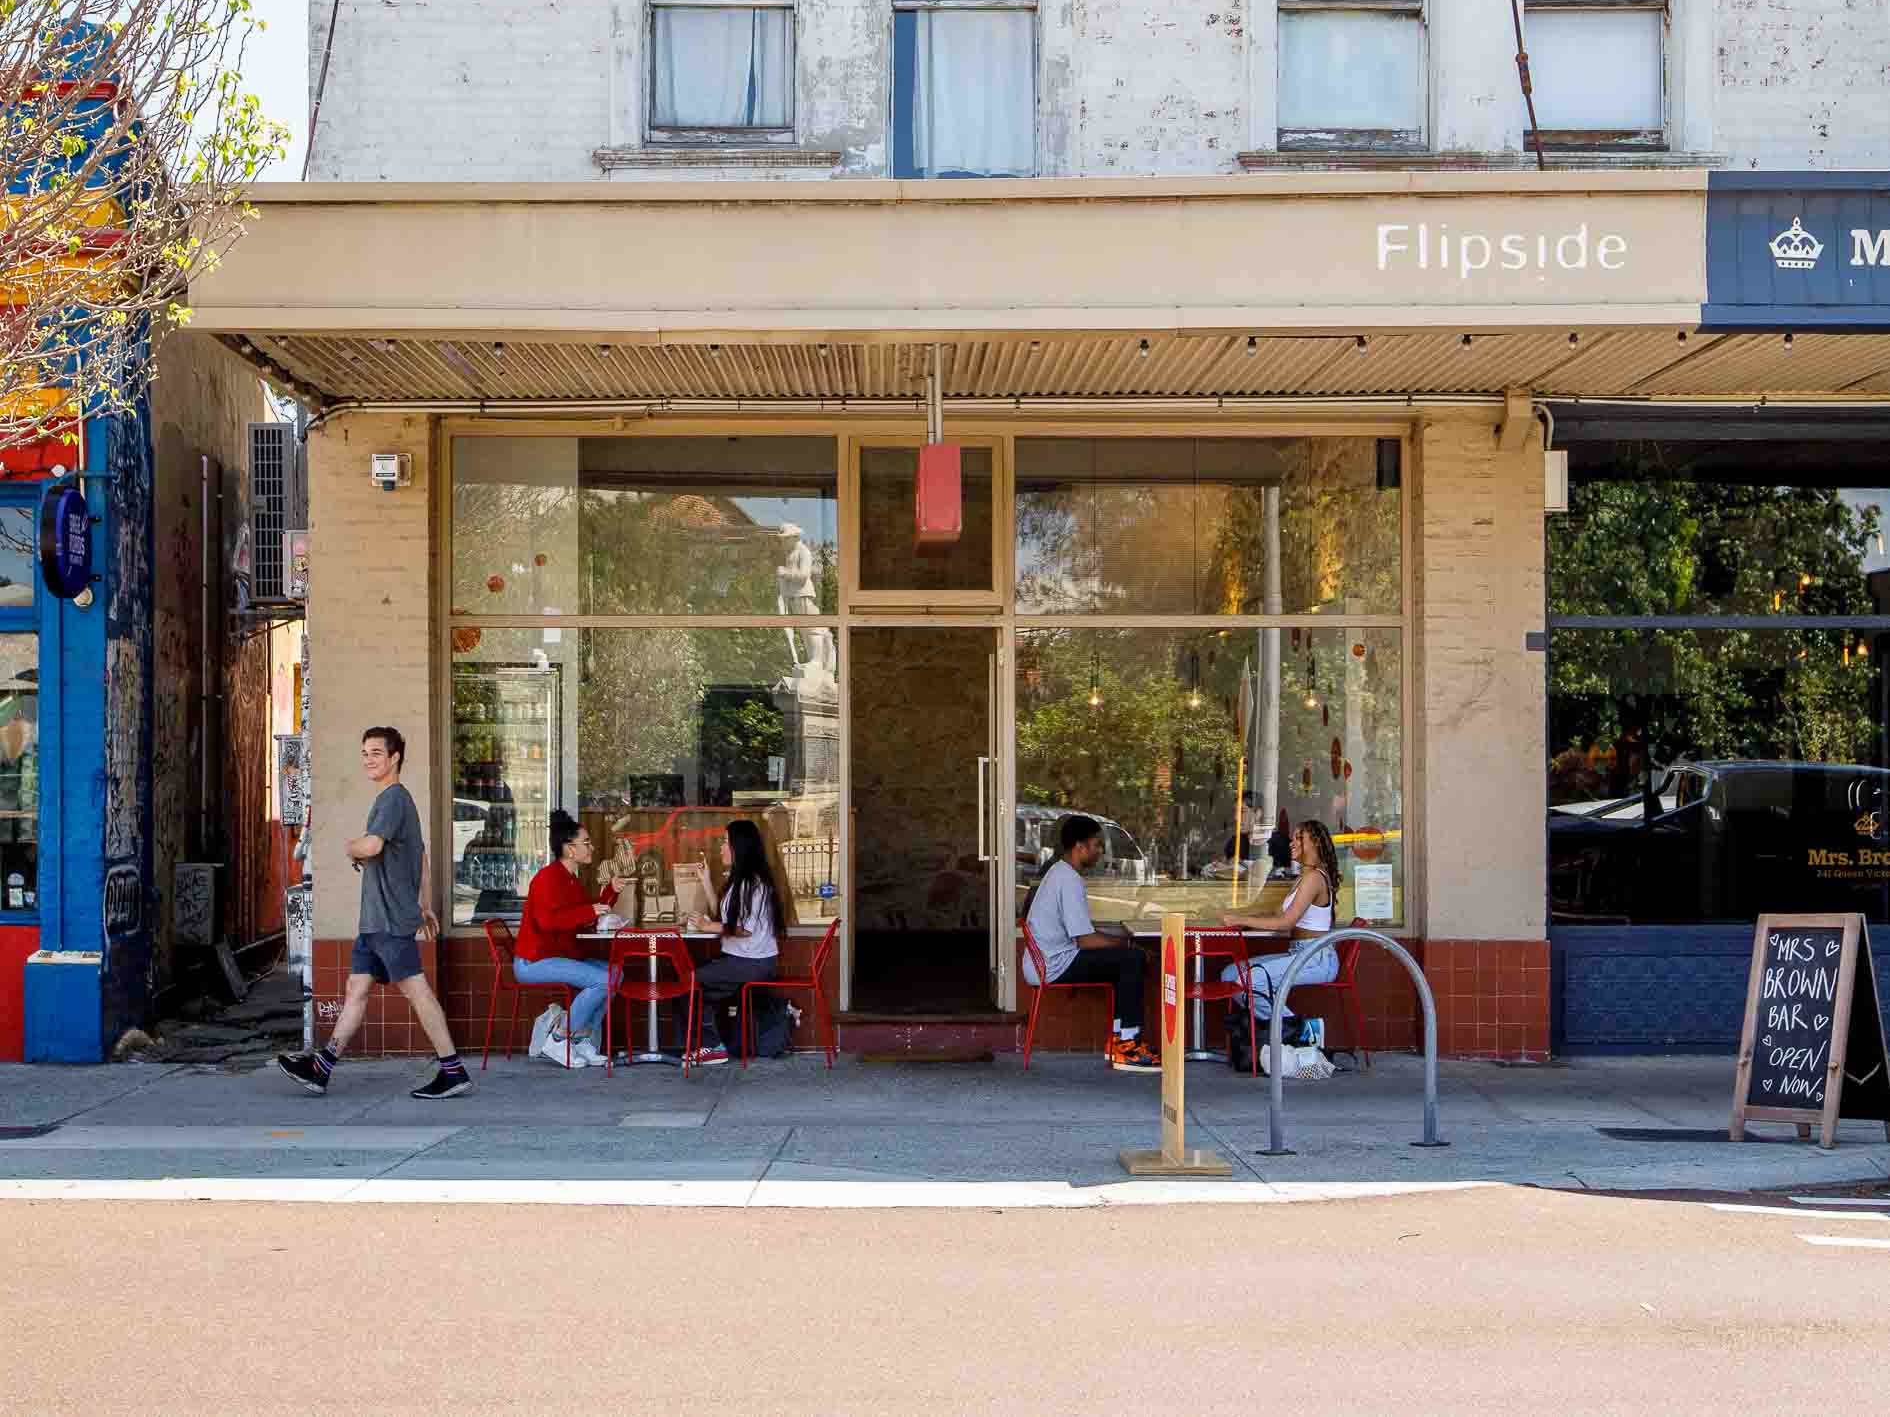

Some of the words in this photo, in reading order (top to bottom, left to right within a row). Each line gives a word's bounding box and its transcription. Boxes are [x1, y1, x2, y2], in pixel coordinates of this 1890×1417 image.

[1377, 223, 1627, 278] Flipside
[1808, 848, 1854, 865] Mrs.
[1777, 938, 1816, 962] MRS
[1763, 967, 1838, 1002] BROWN
[1768, 1004, 1808, 1031] BAR
[1769, 1040, 1828, 1071] OPEN
[1779, 1075, 1822, 1098] NOW
